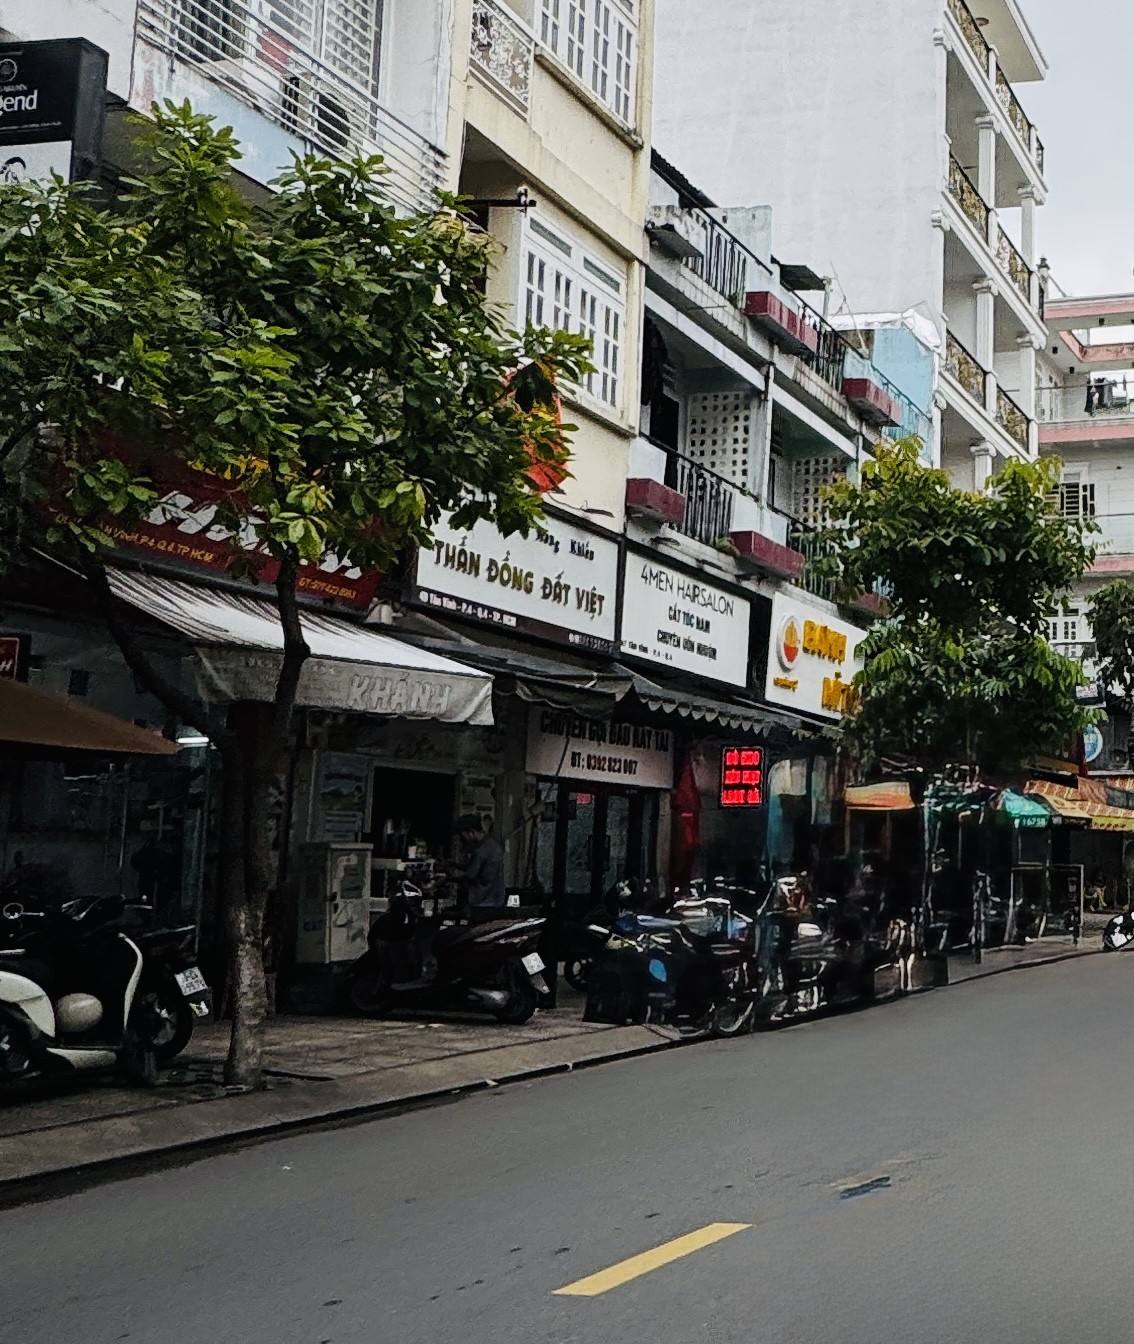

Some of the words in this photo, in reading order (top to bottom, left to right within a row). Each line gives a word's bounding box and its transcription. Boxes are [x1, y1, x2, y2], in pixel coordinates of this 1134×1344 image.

[0, 89, 38, 116] end
[541, 570, 571, 606] ĐẤT
[575, 586, 605, 620] VIỆT
[641, 564, 674, 595] 4MEN
[350, 671, 450, 714] KHÁNH
